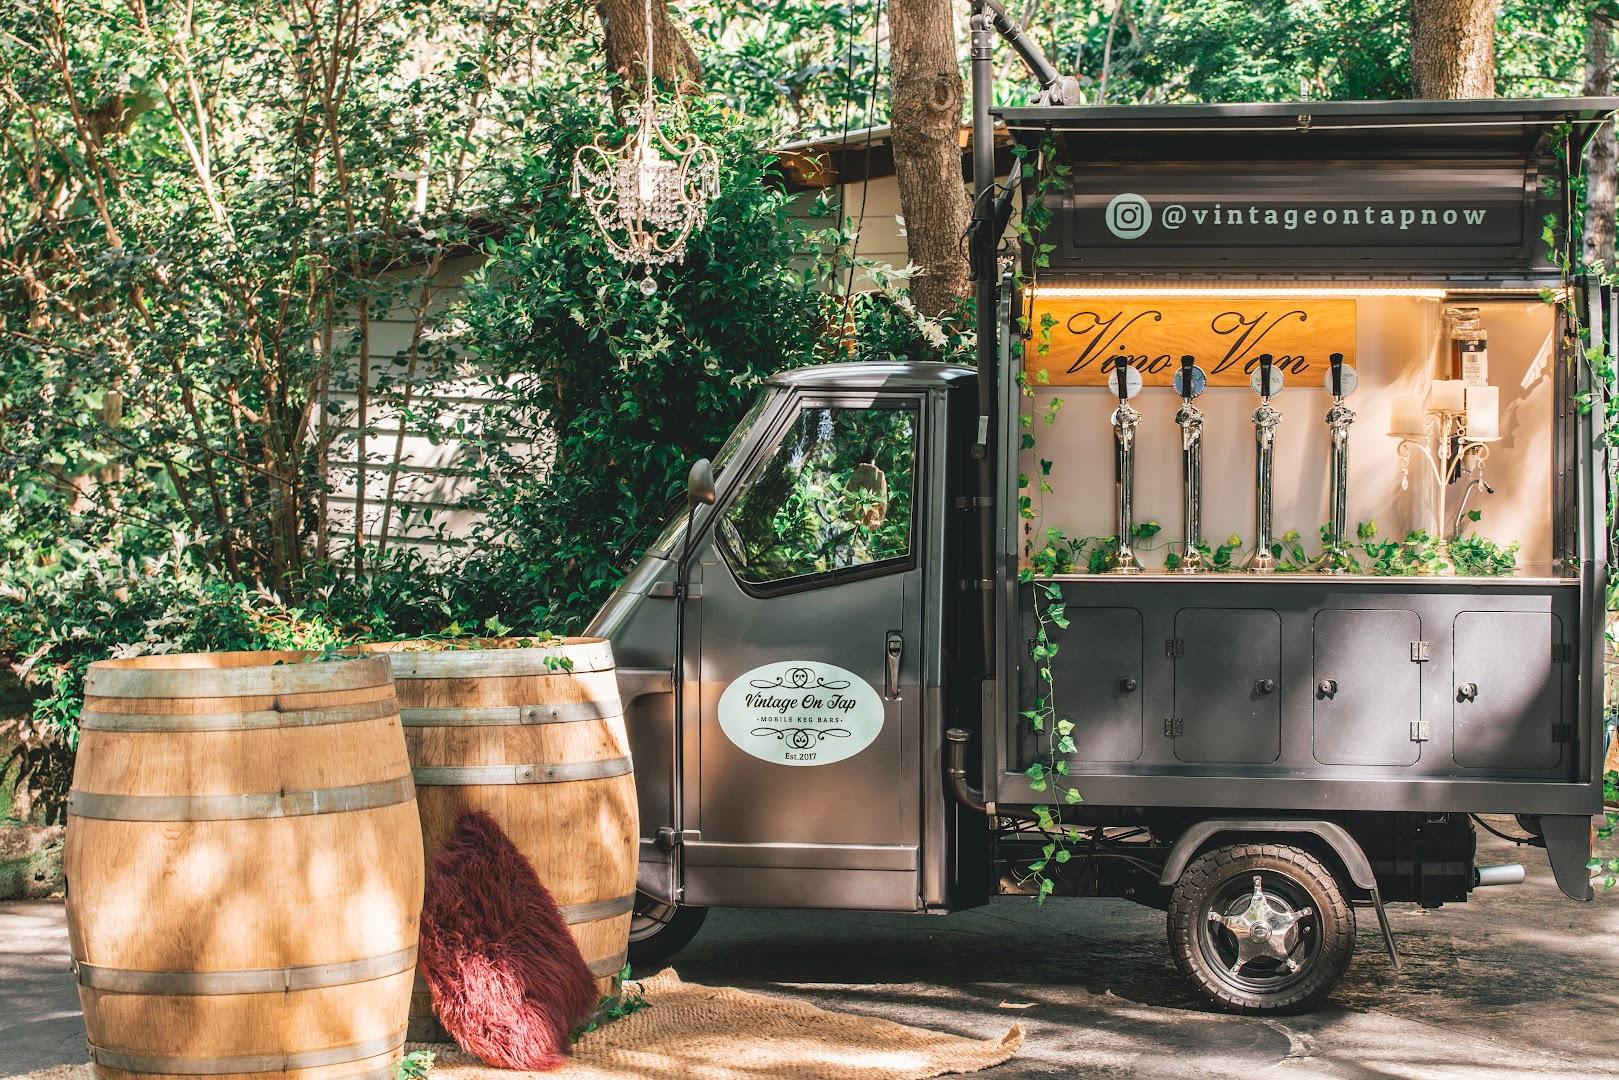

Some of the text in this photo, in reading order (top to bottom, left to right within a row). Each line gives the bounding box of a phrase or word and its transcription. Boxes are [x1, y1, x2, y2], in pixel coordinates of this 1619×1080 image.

[1161, 204, 1487, 230] @vintageontapnow
[1066, 310, 1172, 375] Vino
[745, 691, 857, 714] Vintage On Tap
